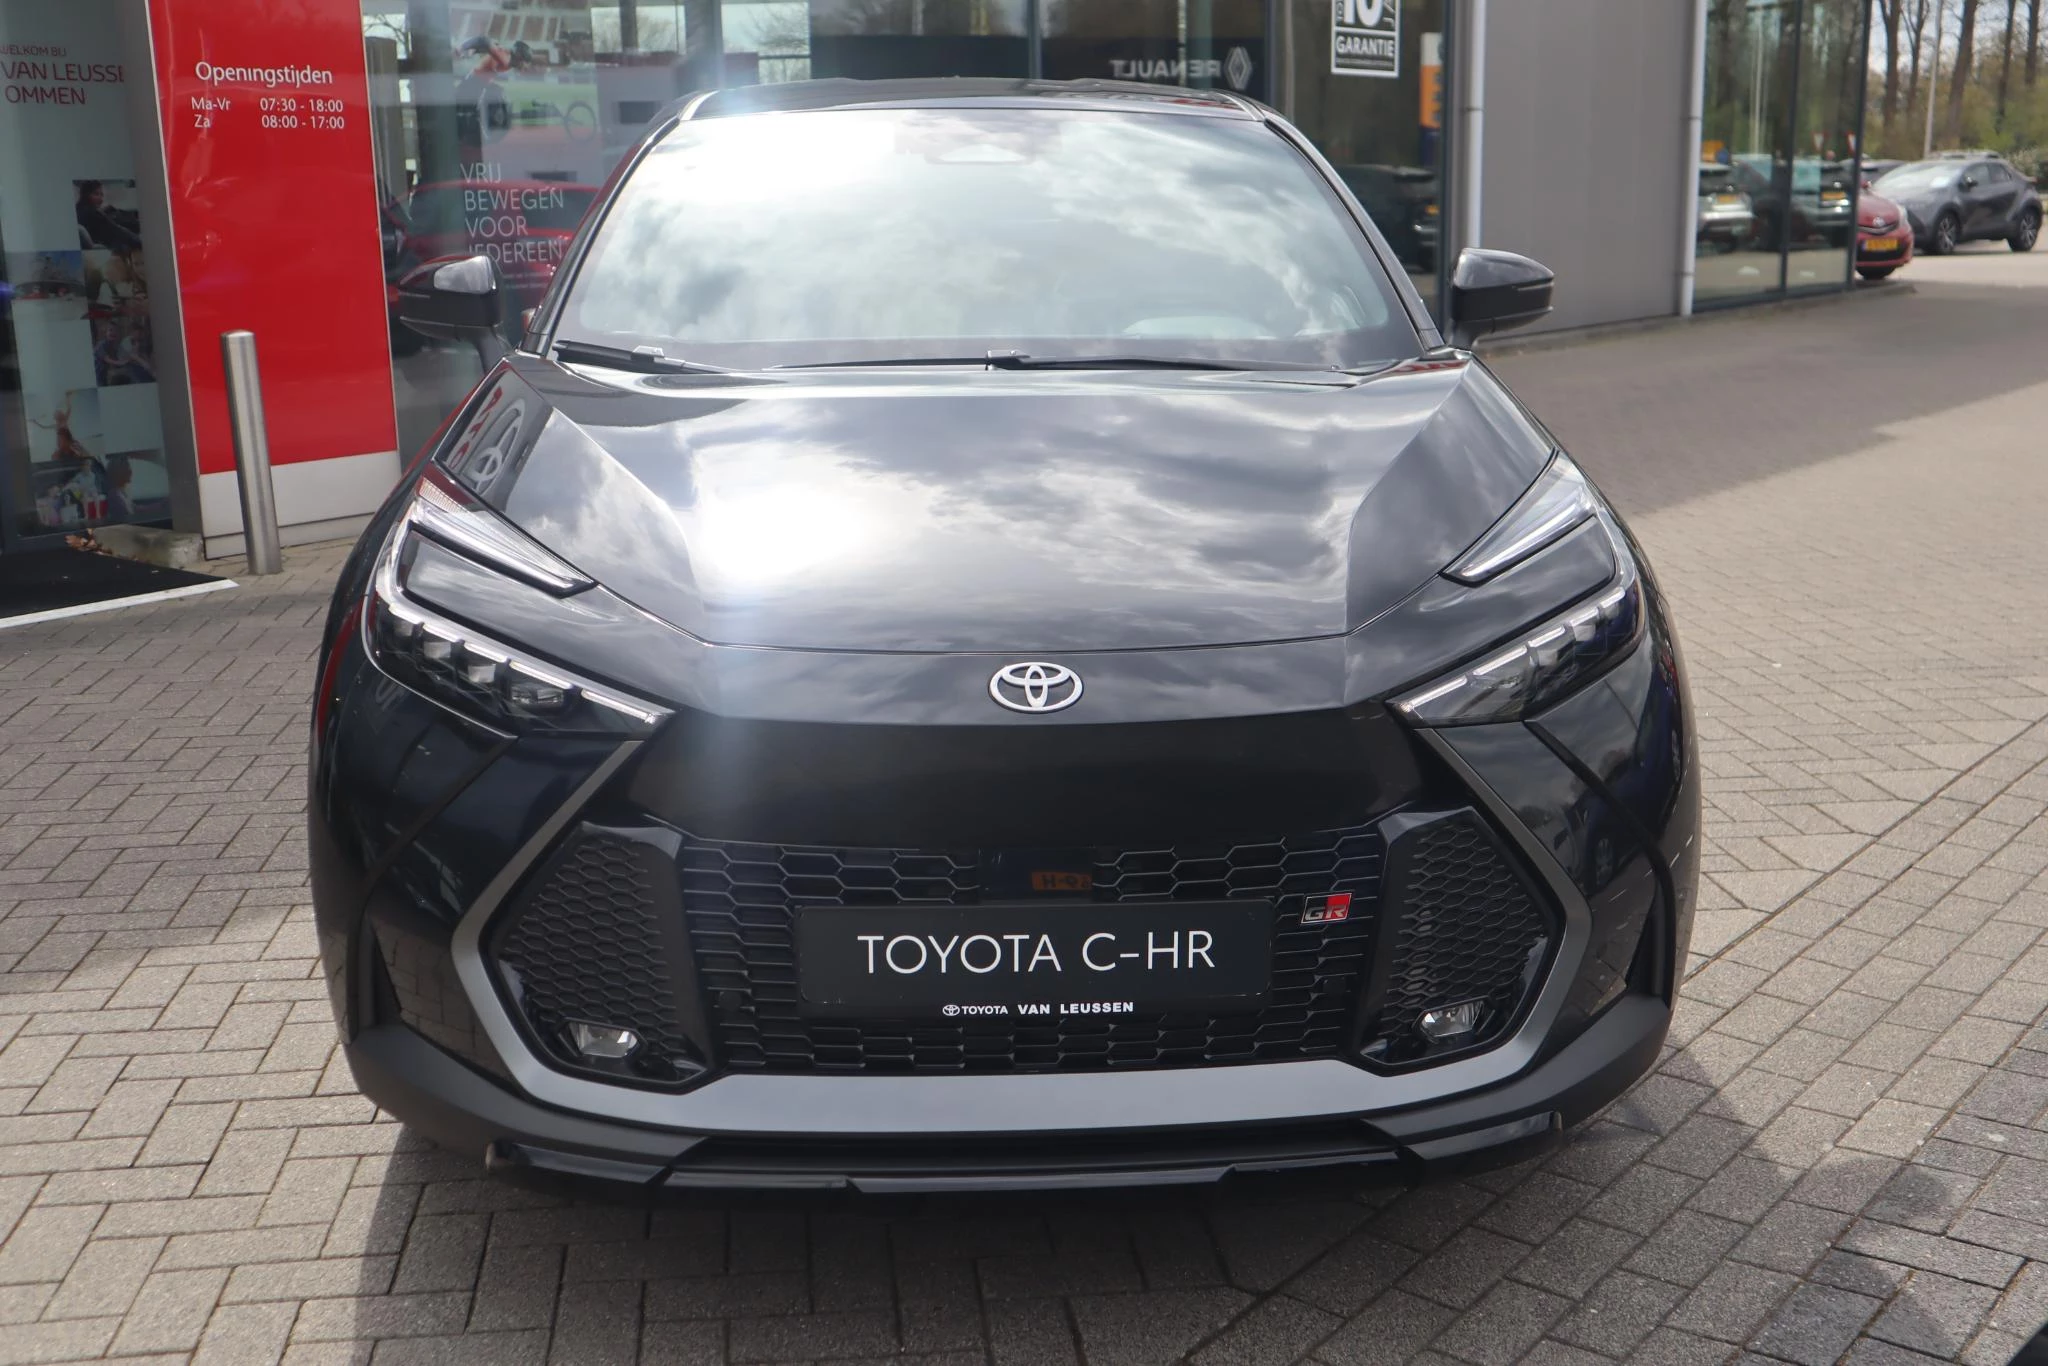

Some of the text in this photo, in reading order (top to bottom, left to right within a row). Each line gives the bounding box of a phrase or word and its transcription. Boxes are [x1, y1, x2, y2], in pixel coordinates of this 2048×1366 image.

[1336, 35, 1395, 57] GARANTIE
[0, 61, 48, 80] VAN
[195, 61, 333, 88] Openingstijden
[4, 85, 86, 105] OMMEN
[191, 96, 231, 111] Ma-Vr
[259, 97, 296, 112] 07:30
[309, 99, 344, 113] 18:00
[194, 114, 211, 128] Za
[261, 114, 298, 129] 08:00
[310, 116, 345, 129] 17:00
[460, 161, 501, 184] VRIJ
[464, 187, 564, 211] BEWEGEN
[464, 215, 529, 238] VOOR
[1304, 904, 1346, 921] GR
[857, 930, 1216, 974] TOYOTA C-HR
[962, 1002, 1134, 1015] TOYOTA VAN LEUSSEN
